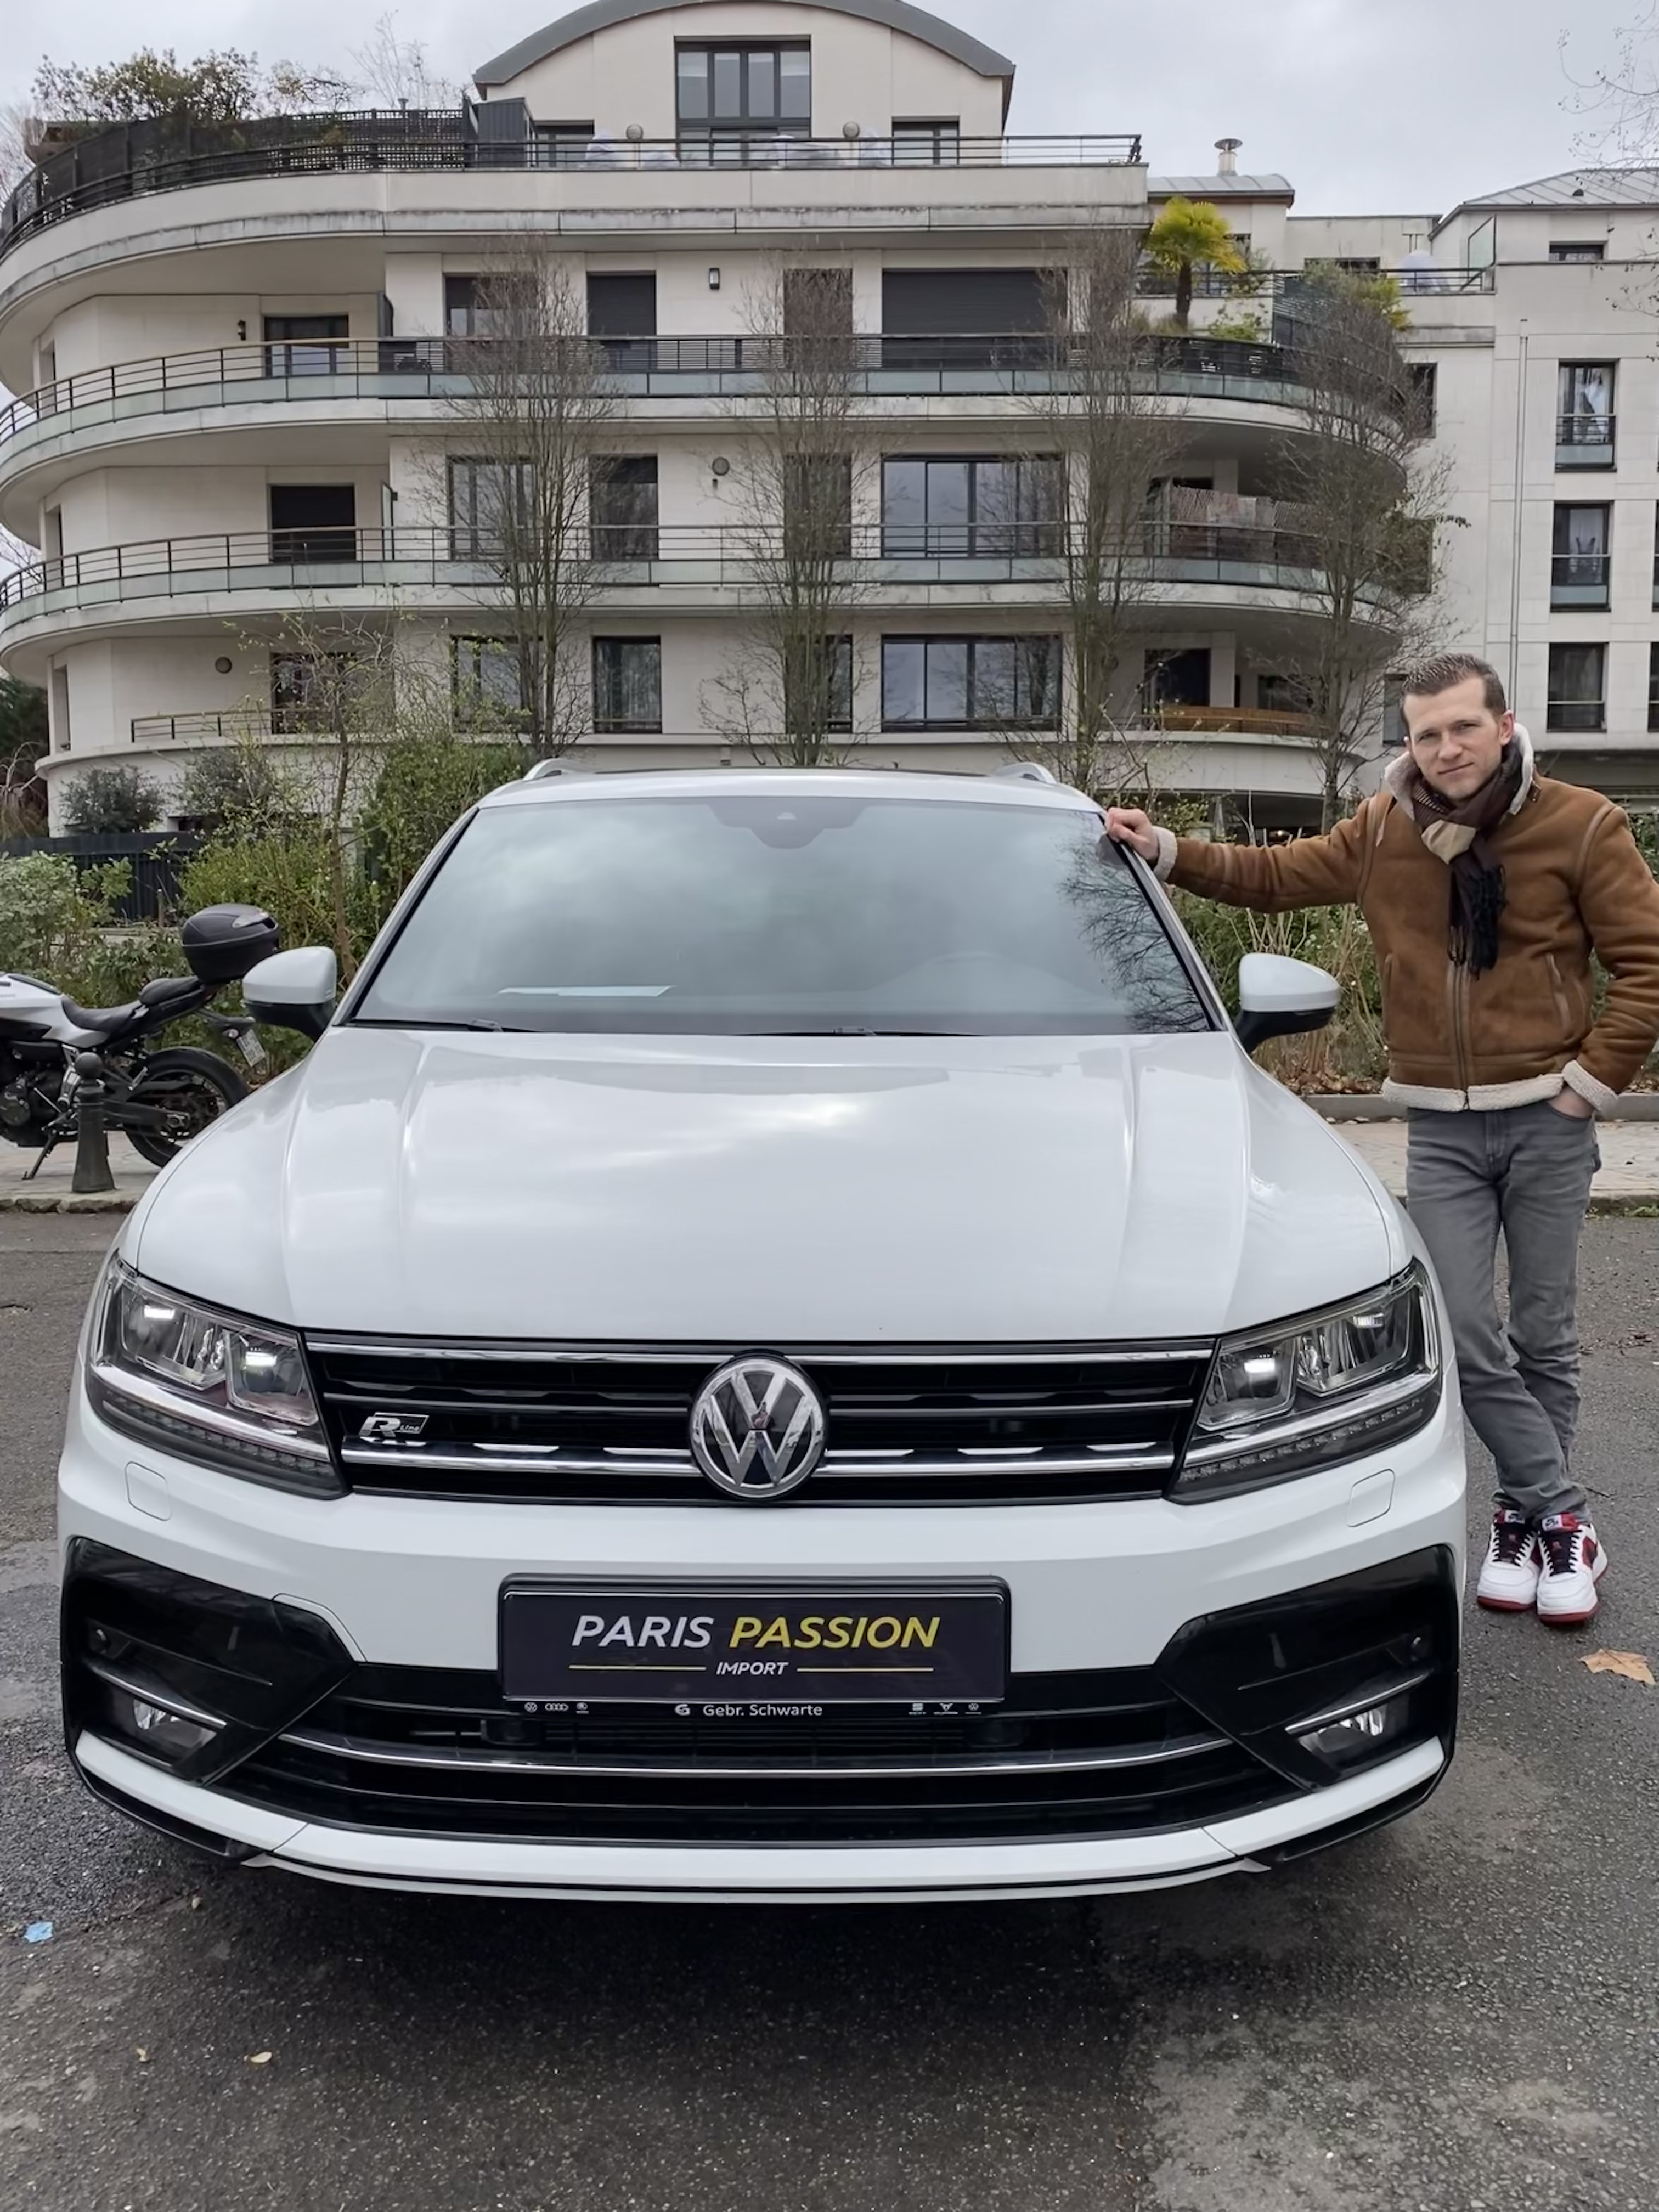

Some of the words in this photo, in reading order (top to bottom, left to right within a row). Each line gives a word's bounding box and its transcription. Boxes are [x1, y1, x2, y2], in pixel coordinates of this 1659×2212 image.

[358, 1416, 401, 1438] R
[571, 1615, 714, 1648] PARIS
[728, 1616, 940, 1650] PASSION
[715, 1662, 788, 1677] IMPORT
[703, 1704, 744, 1716] Gebr.
[749, 1704, 823, 1716] Schwarte
